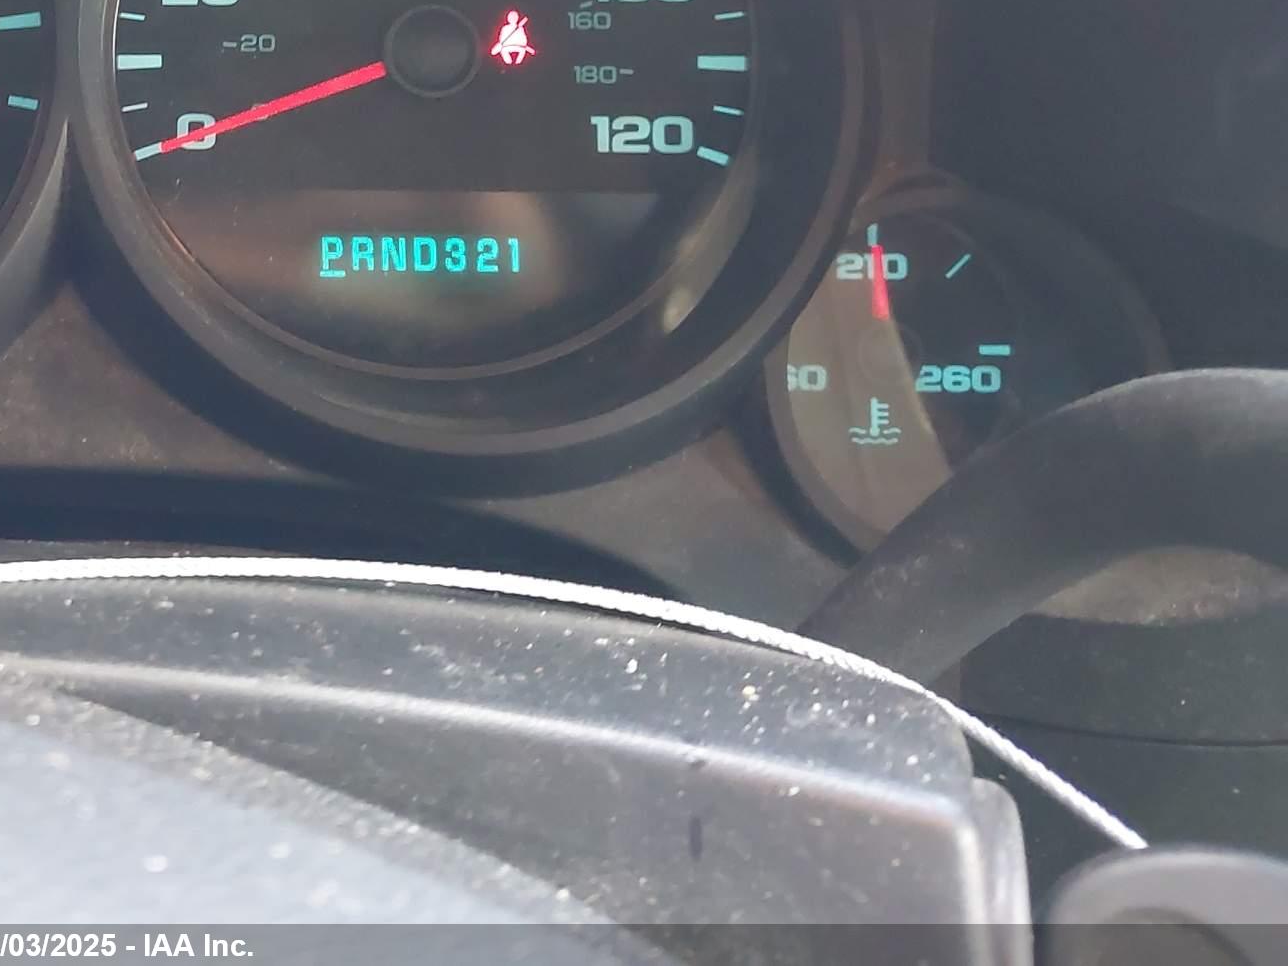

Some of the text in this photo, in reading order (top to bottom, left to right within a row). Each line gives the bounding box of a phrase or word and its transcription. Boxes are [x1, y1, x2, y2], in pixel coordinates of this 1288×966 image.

[567, 11, 611, 30] 160
[240, 34, 275, 53] 20
[574, 65, 618, 84] 180
[177, 113, 217, 150] 0
[590, 116, 694, 153] 120
[320, 235, 522, 274] PRND321
[915, 365, 1001, 393] 260
